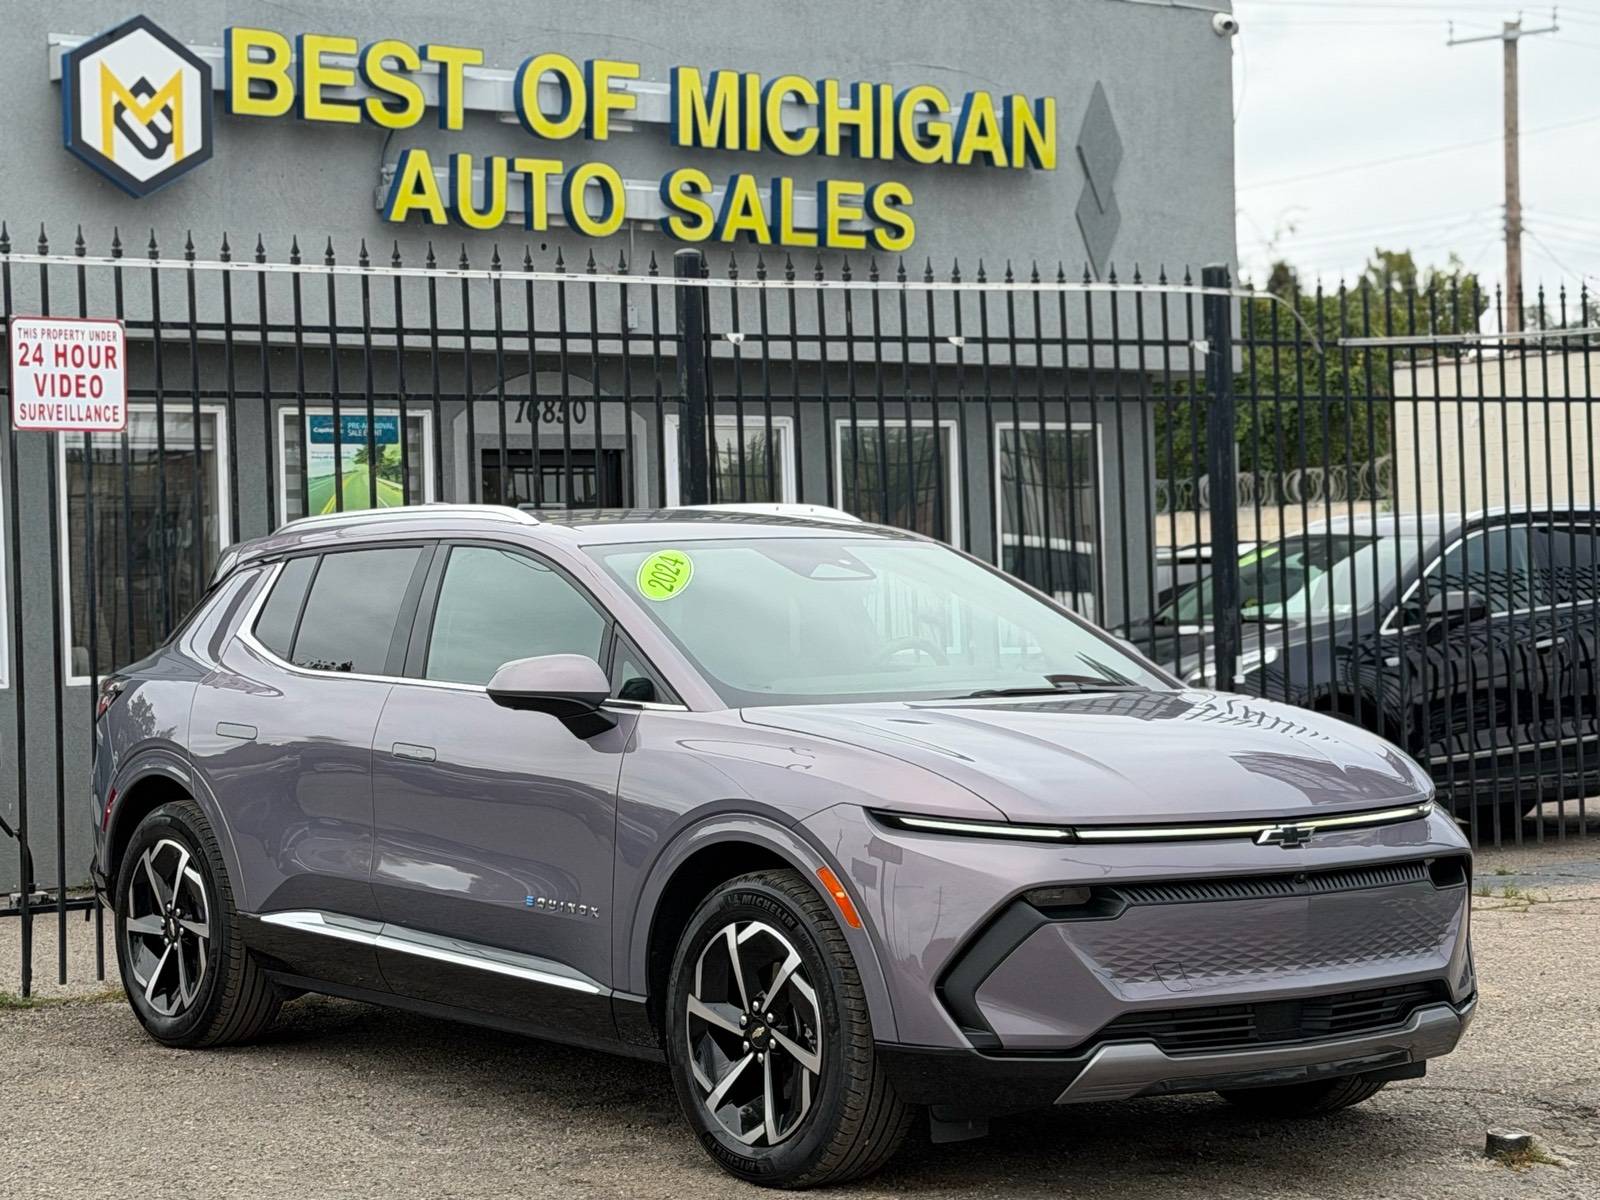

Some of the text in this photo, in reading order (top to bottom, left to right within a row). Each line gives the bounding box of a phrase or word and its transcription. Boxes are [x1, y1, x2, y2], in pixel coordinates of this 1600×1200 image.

[227, 28, 1057, 170] BEST OF MICHIGAN
[386, 150, 915, 251] AUTO SALES
[17, 327, 118, 342] THIS PROPERTY UNDER
[18, 342, 118, 370] 24 HOUR
[34, 373, 103, 399] VIDEO
[19, 403, 120, 423] SURVEILLANCE
[647, 555, 684, 592] 2024
[524, 895, 599, 919] EQUINOX
[741, 894, 796, 929] MICHELIN
